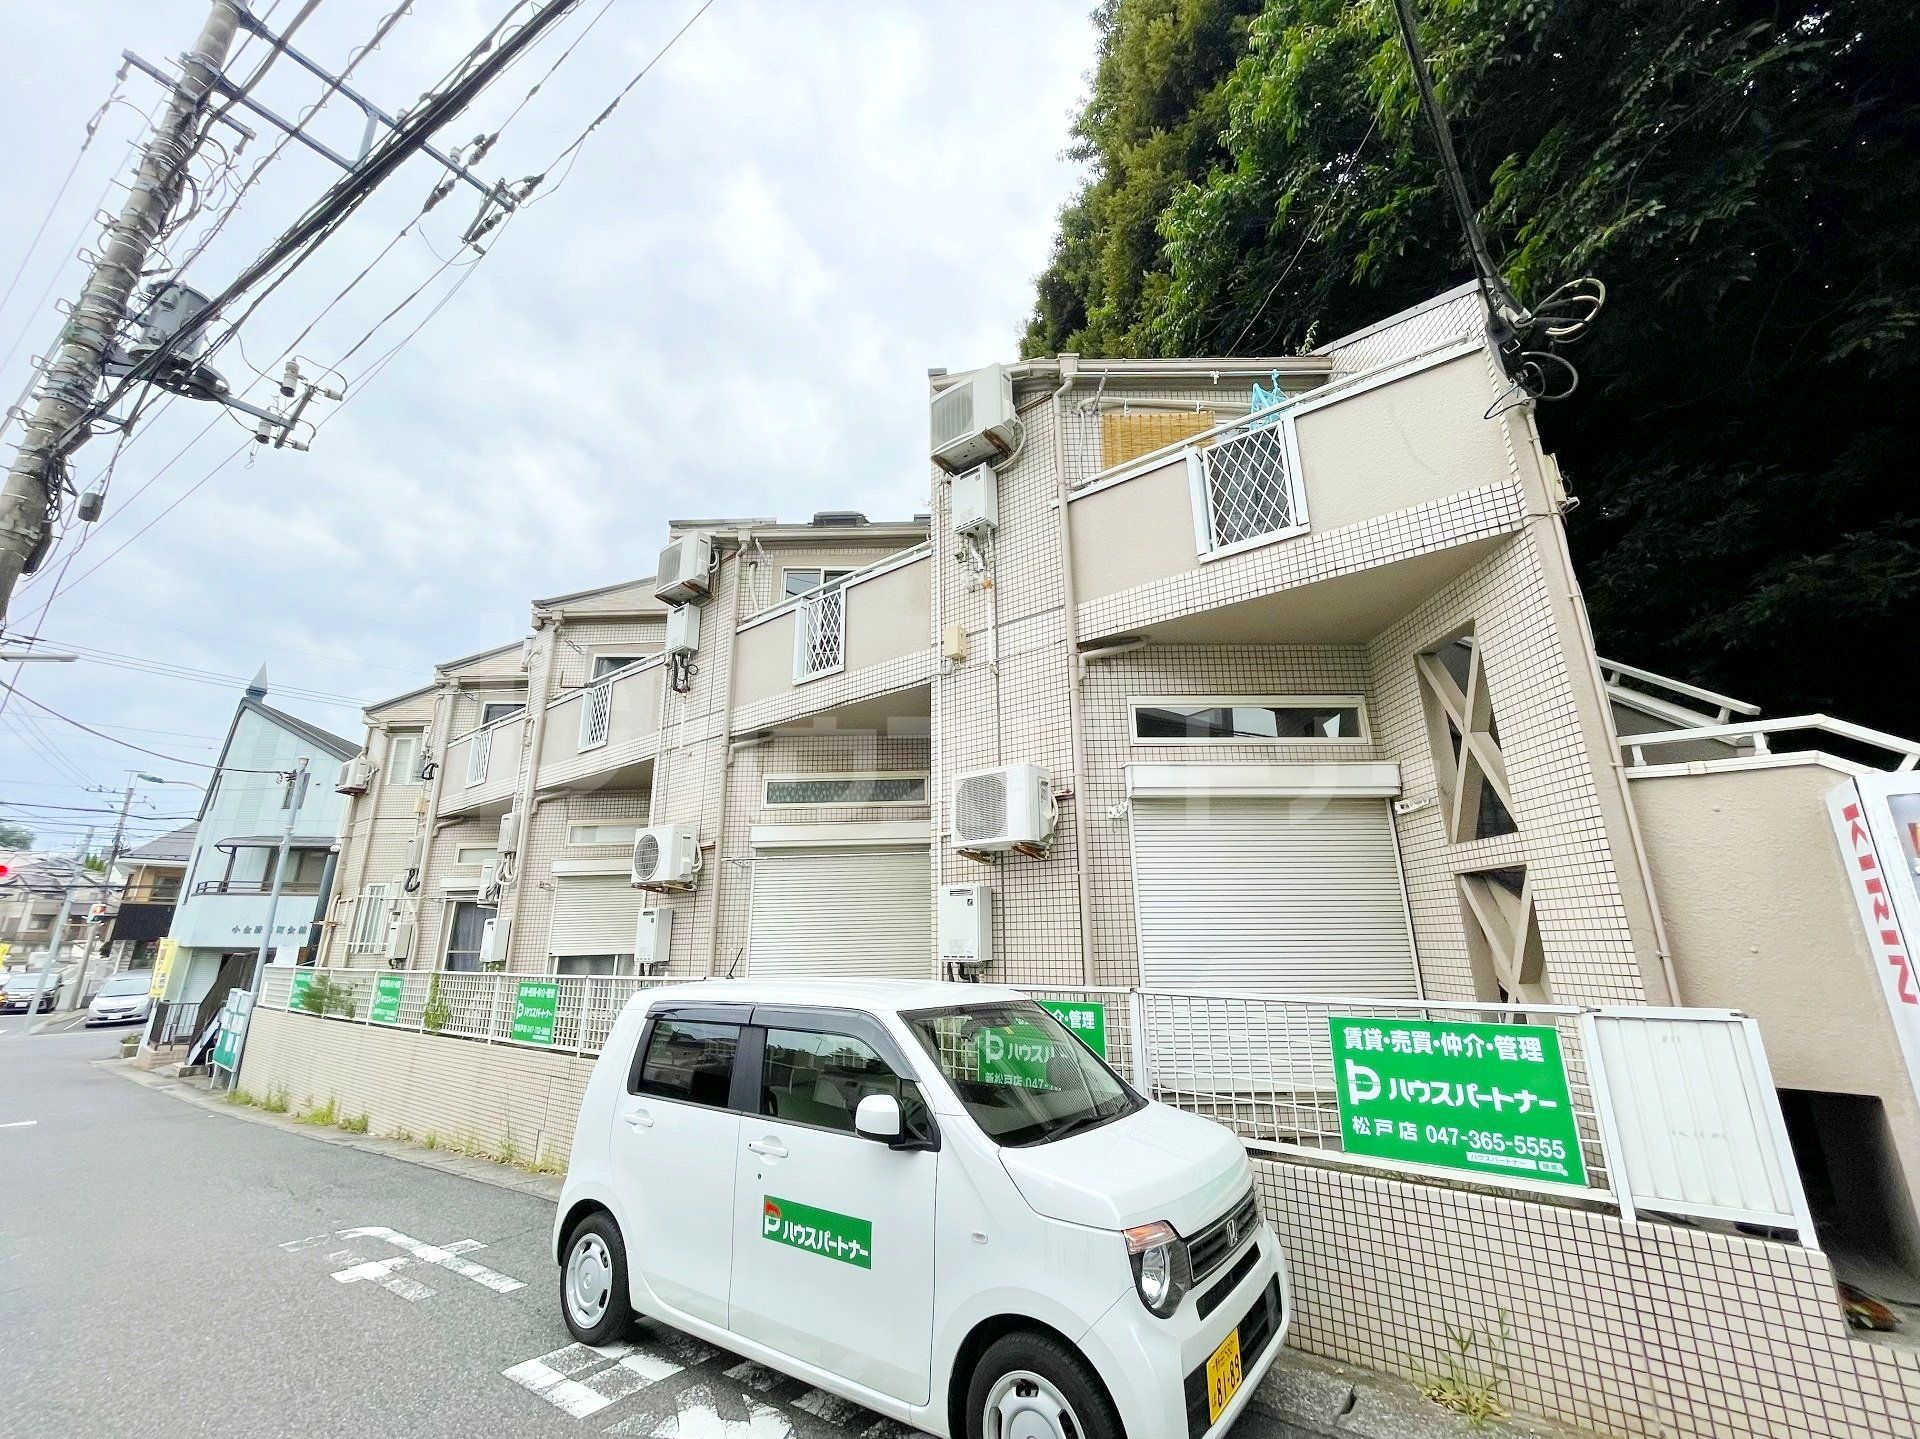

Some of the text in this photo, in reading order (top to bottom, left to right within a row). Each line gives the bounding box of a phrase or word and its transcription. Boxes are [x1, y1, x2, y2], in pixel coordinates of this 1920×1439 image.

[1842, 803, 1918, 1005] KIRIN
[1343, 1027, 1544, 1062] 賃貸・売買・仲介・管理
[1389, 1078, 1557, 1113] ハウスパートナー
[1352, 1116, 1566, 1159] 松戸店 047-365-5555
[783, 1220, 869, 1259] ハウスパートナー
[1216, 1354, 1241, 1408] 81-89
